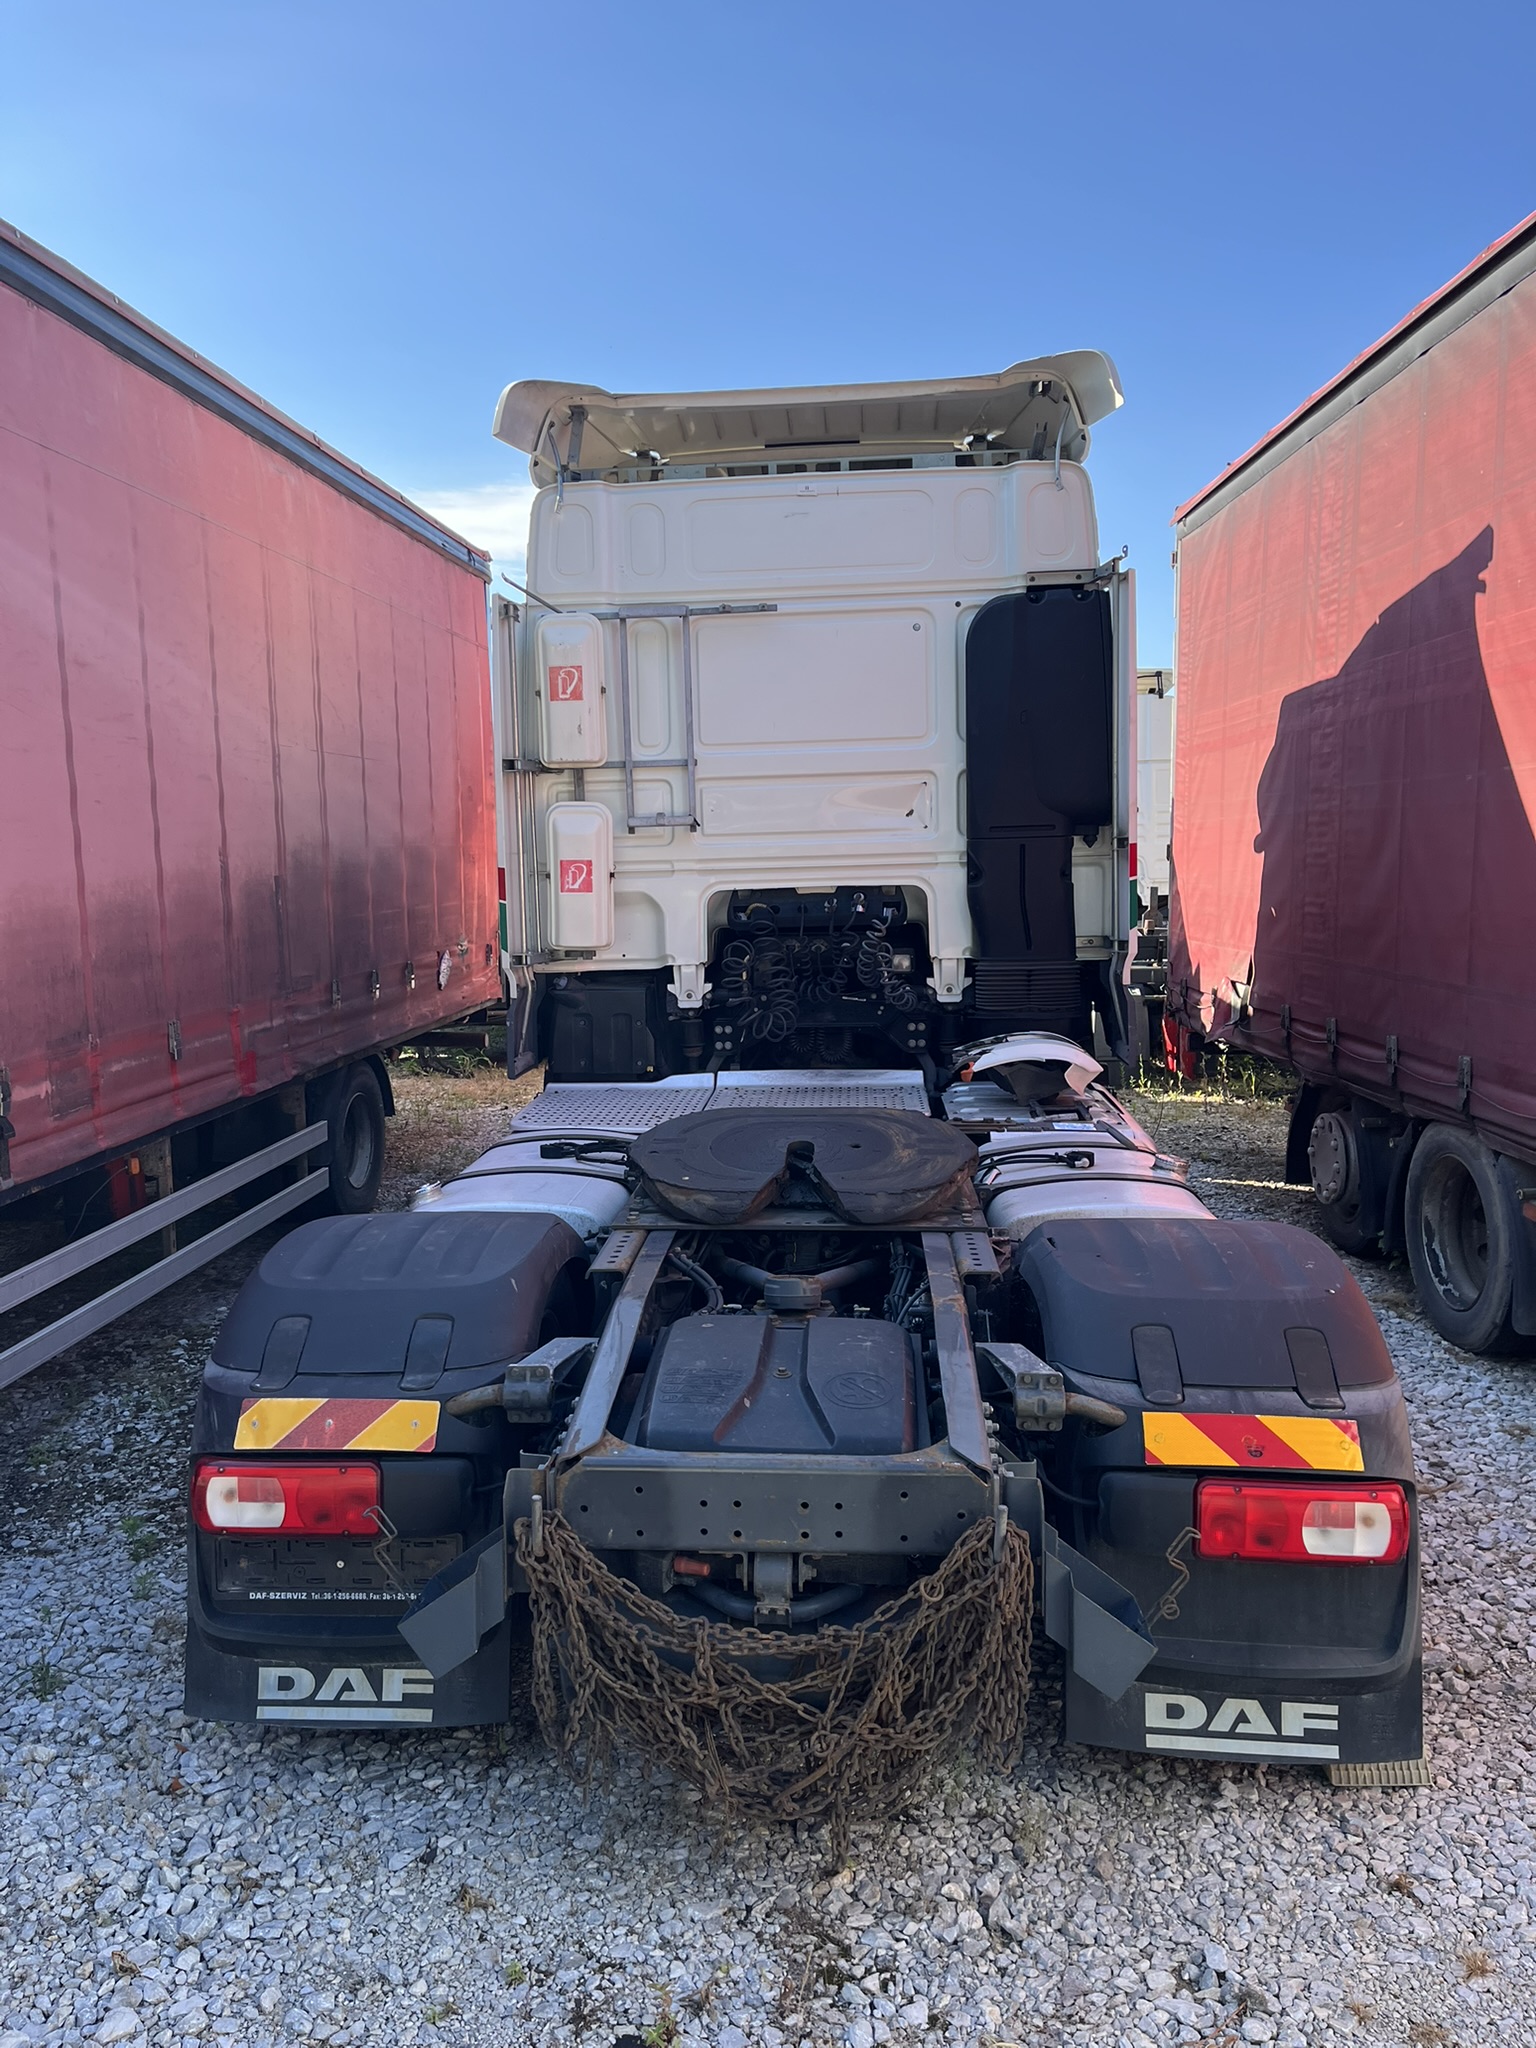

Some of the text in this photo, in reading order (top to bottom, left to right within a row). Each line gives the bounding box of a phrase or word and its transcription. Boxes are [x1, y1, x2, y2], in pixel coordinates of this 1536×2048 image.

[249, 1592, 308, 1600] DAF-SZERVIZ
[257, 1666, 435, 1702] DAF
[1144, 1692, 1340, 1737] DAF
